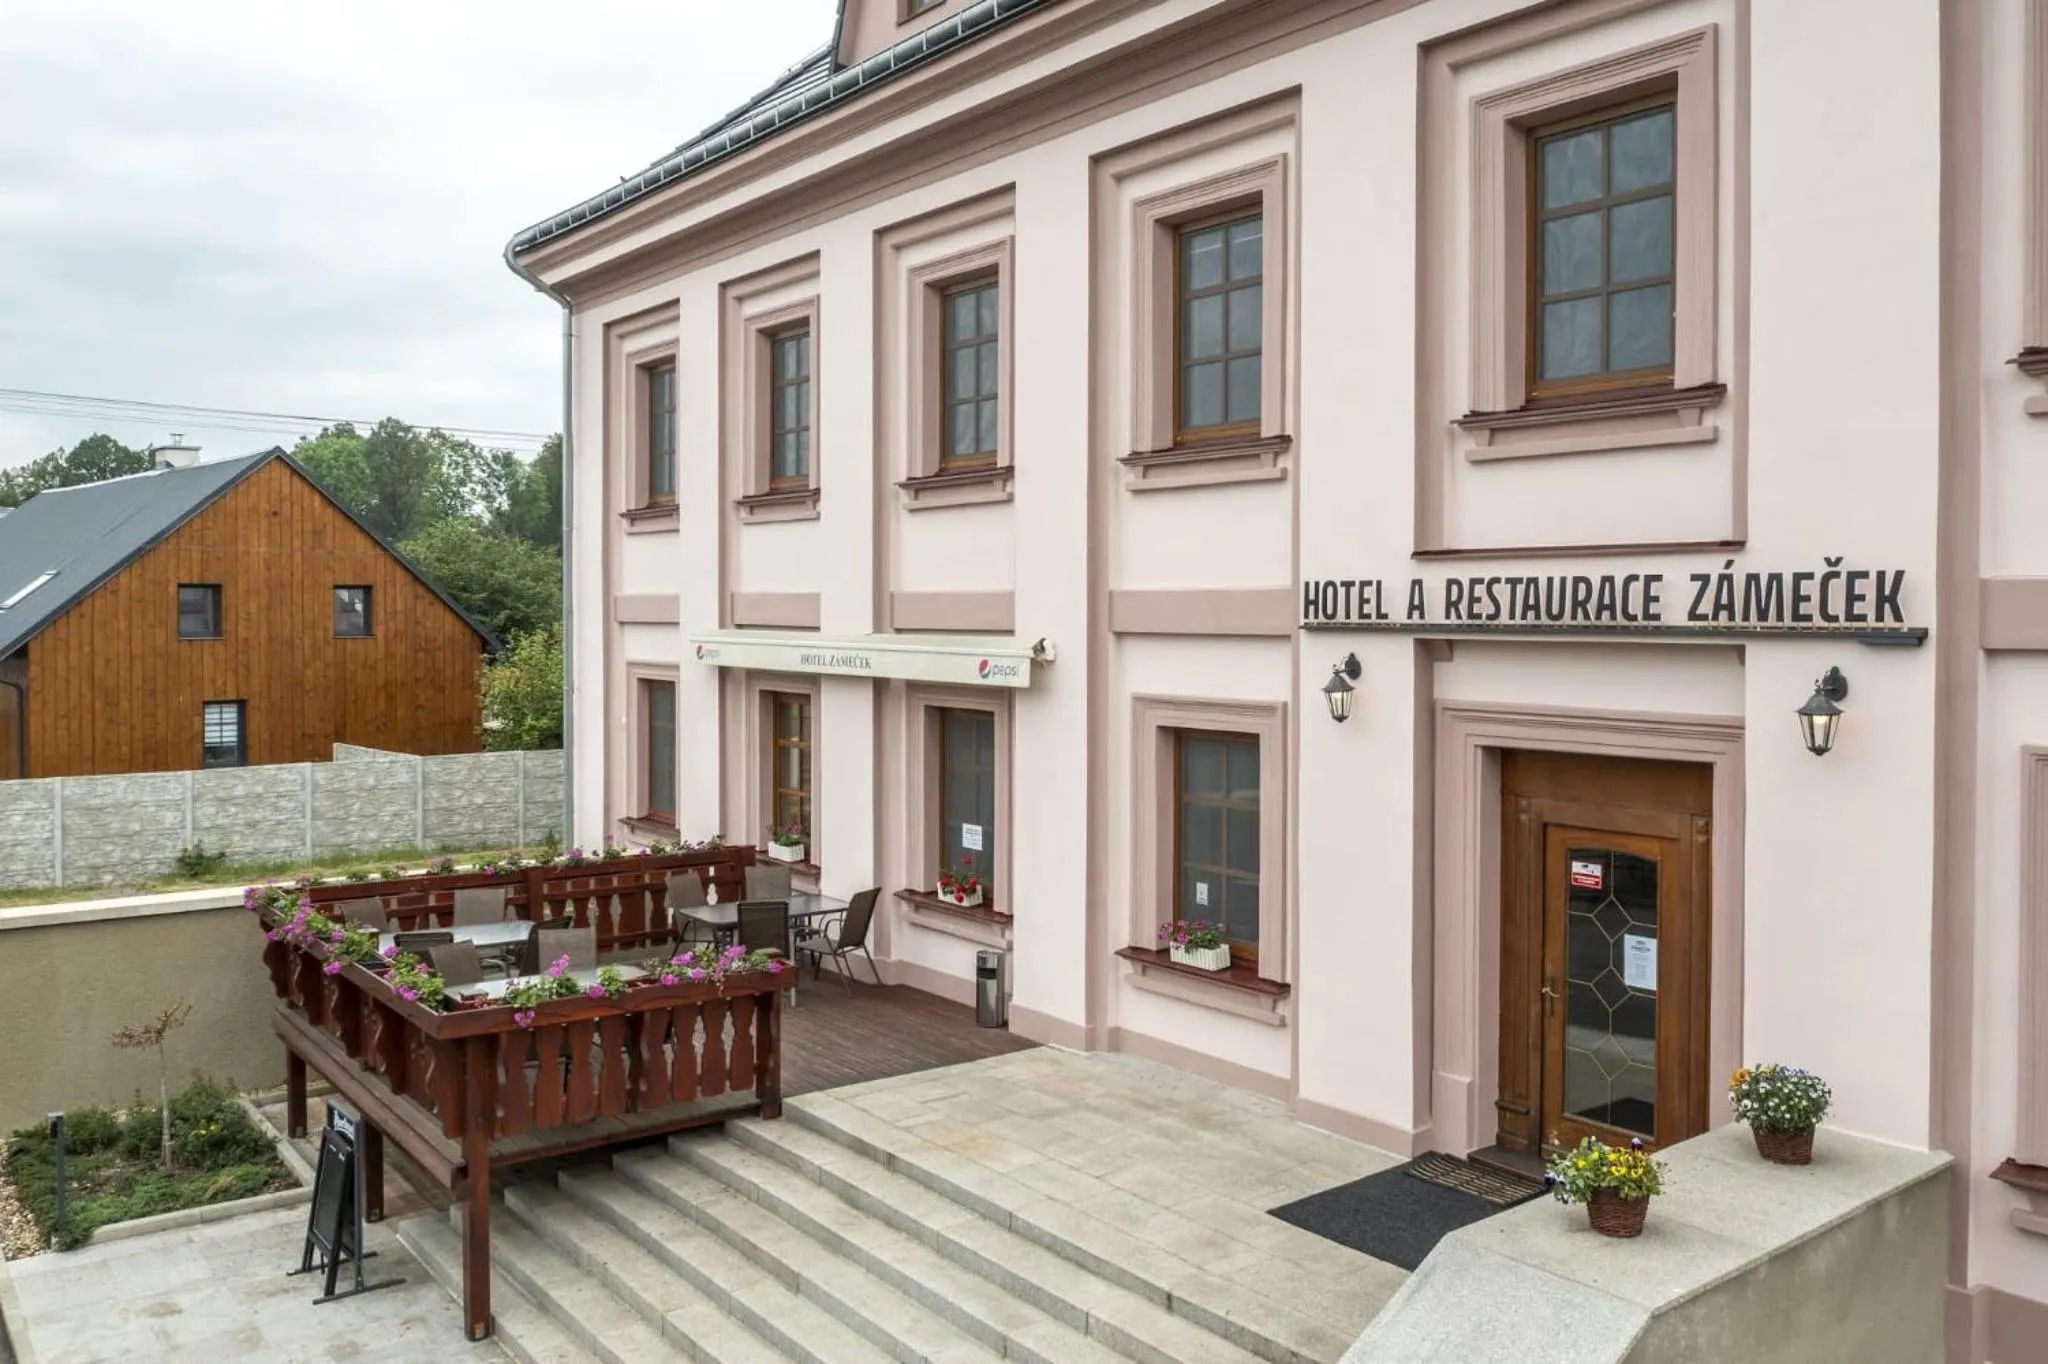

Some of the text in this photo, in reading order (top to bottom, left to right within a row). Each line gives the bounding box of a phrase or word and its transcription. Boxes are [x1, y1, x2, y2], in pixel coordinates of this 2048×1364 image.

[1303, 556, 1906, 623] HOTEL A RESTAURACE ZÁMEČEK
[800, 653, 827, 667] HOTEL
[992, 664, 1019, 678] pepsi
